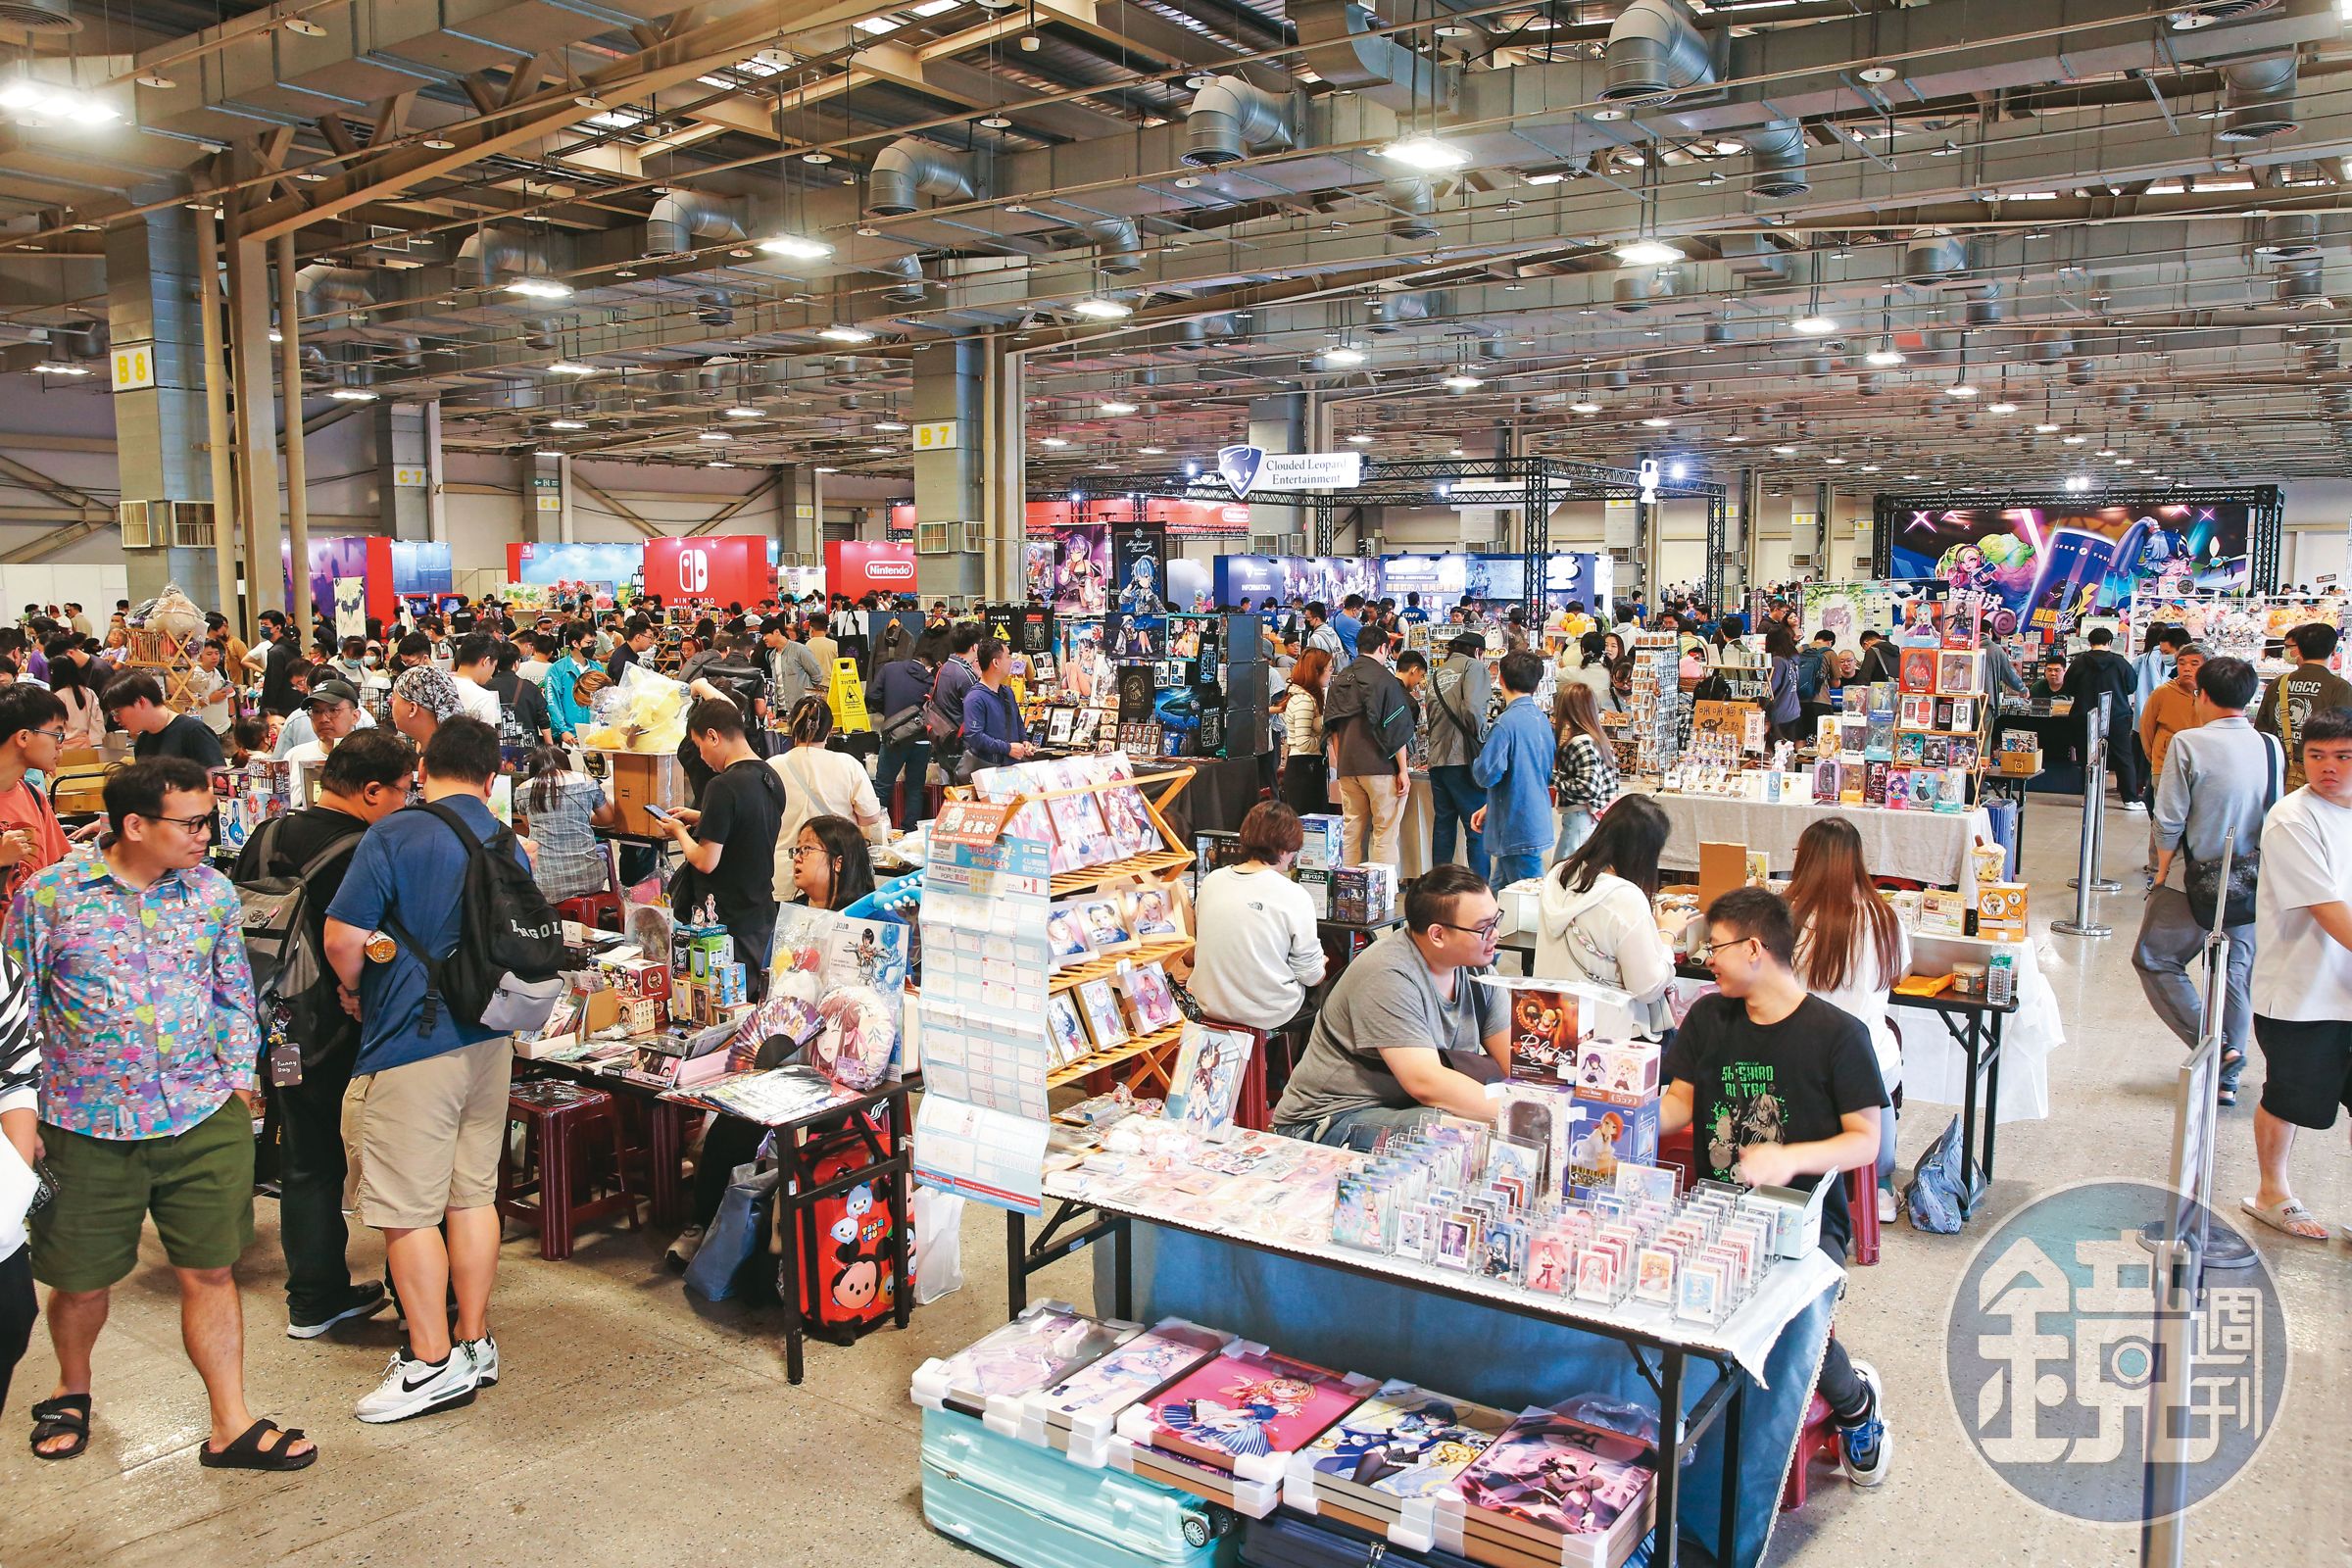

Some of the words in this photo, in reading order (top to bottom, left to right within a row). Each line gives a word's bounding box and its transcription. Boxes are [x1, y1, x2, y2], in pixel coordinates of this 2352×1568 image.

[118, 356, 129, 384] B
[135, 353, 146, 381] 8
[919, 427, 932, 446] B
[939, 426, 950, 445] 7
[1266, 459, 1305, 471] Clouded
[1272, 473, 1341, 485] Entertainment
[869, 564, 909, 575] Nintendo
[2285, 680, 2322, 694] NGCC
